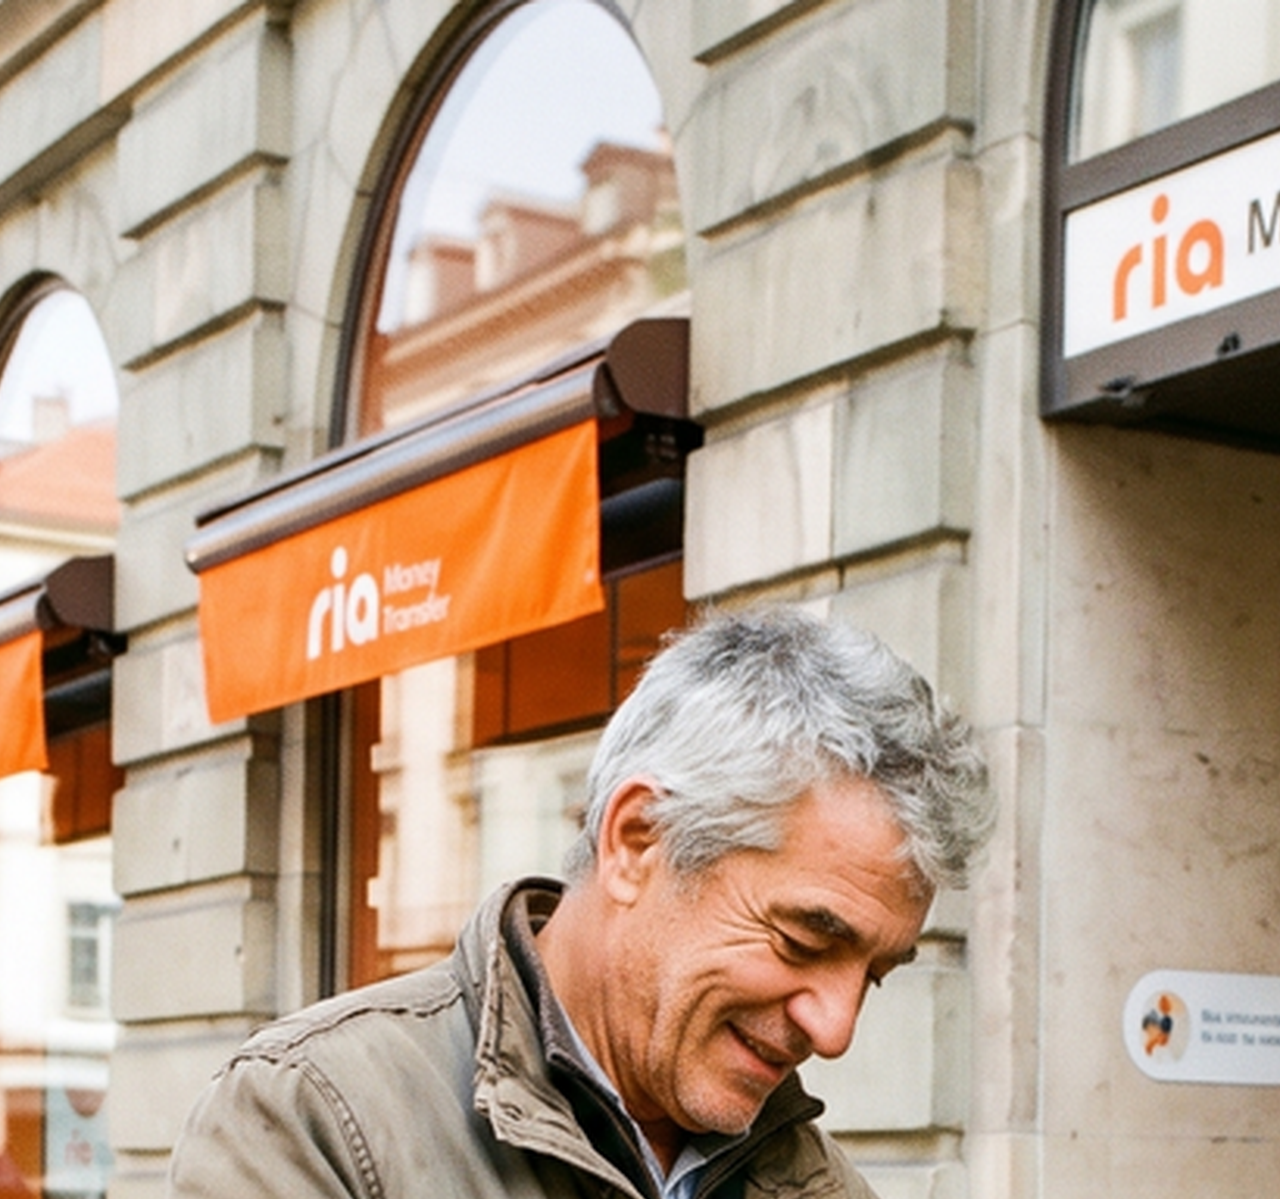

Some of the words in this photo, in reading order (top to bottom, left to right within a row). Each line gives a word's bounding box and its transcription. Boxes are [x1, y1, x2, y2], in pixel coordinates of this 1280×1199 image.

[1113, 193, 1225, 322] ria
[307, 546, 380, 661] ria
[383, 558, 441, 600] Money
